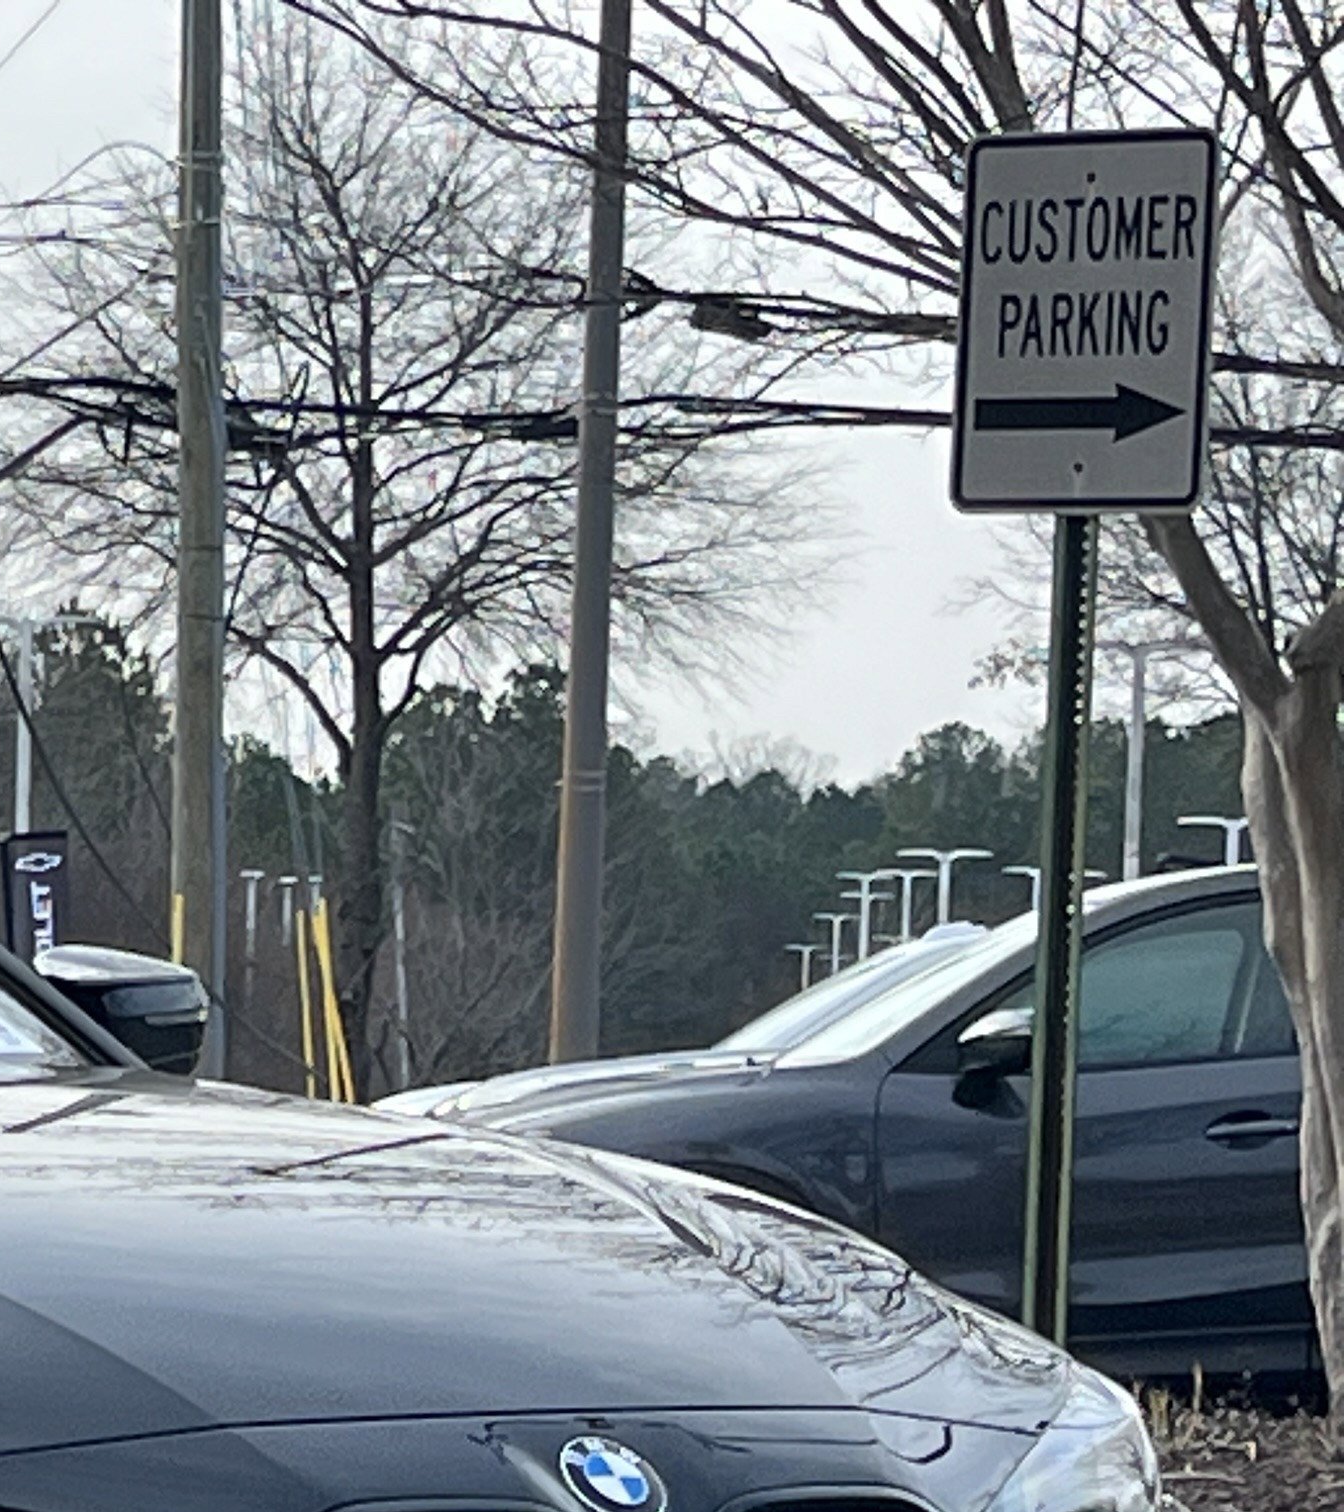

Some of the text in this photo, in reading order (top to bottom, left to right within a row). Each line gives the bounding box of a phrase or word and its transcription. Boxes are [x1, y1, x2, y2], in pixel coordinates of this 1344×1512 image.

[980, 194, 1198, 265] CUSTOMER
[997, 290, 1170, 359] PARKING
[29, 880, 54, 955] OLET
